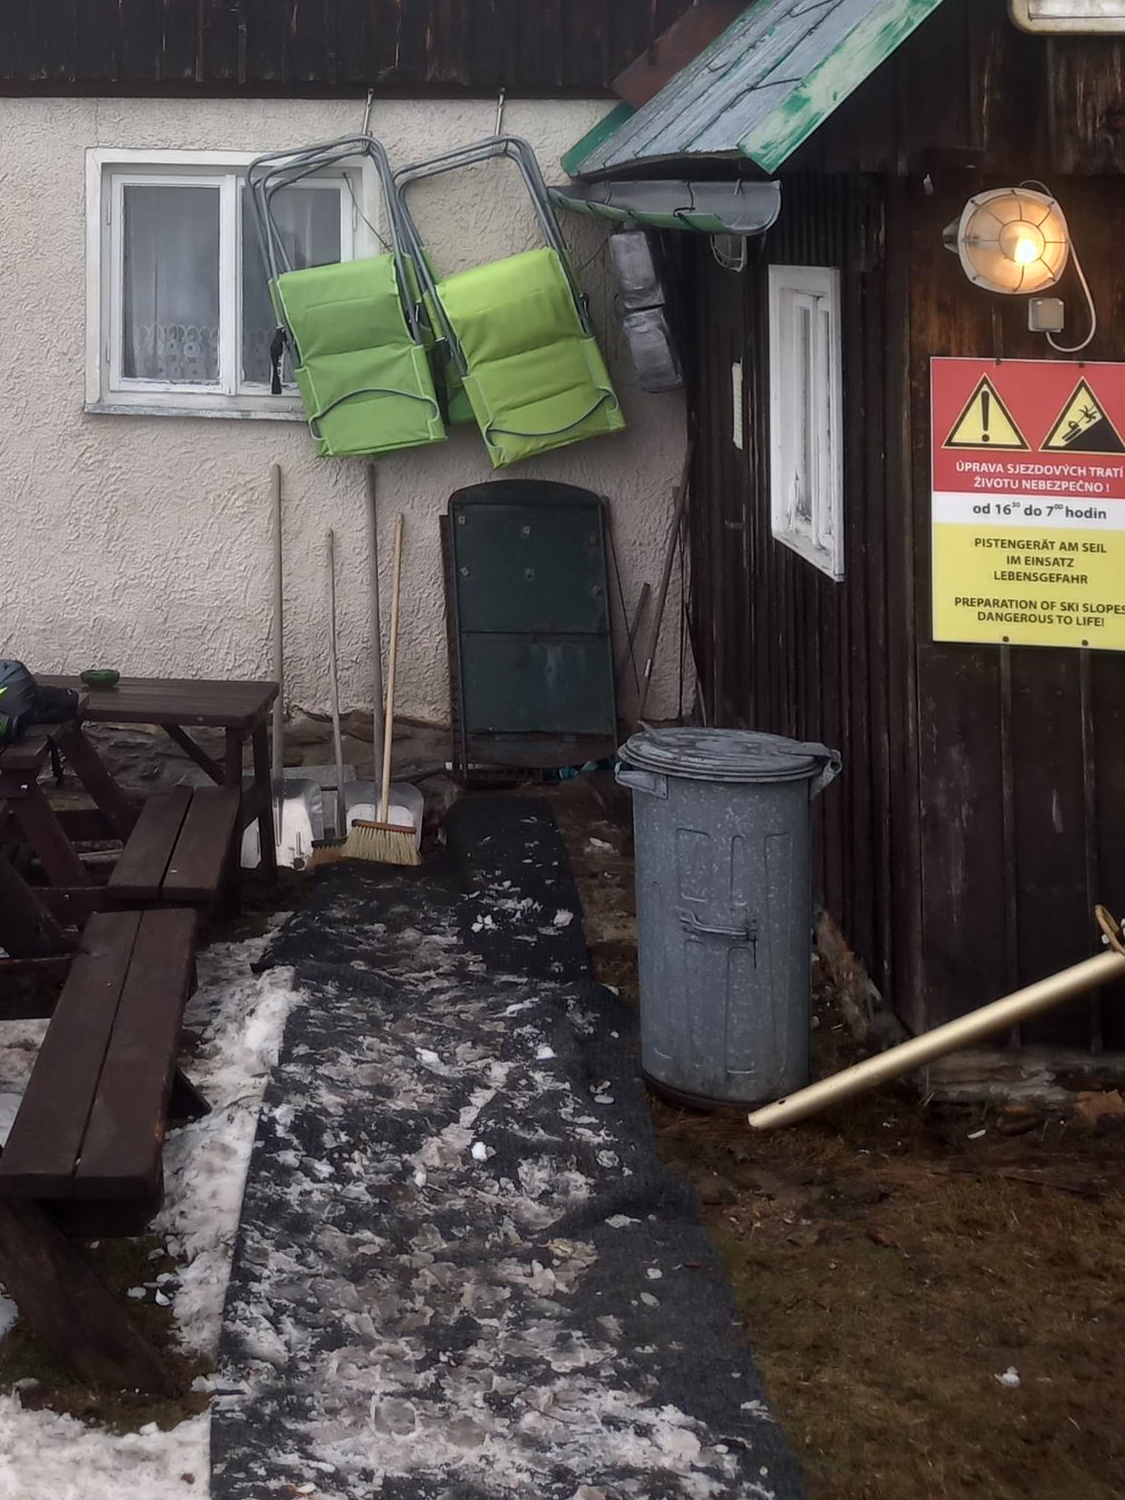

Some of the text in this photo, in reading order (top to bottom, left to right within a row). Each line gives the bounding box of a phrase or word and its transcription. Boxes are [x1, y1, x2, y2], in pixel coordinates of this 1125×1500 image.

[955, 461, 1124, 478] ÚPRAVA SJEZDOVÝCH TRATÍ
[973, 476, 1019, 489] ŽIVOTU
[1022, 479, 1104, 493] NEBEZPEČNO
[972, 503, 991, 515] od
[1024, 505, 1042, 517] do
[1065, 506, 1107, 520] hodin
[974, 538, 1107, 553] PISTENGERÄT AM SEIL
[1006, 555, 1075, 568] IM EINSATZ
[993, 570, 1088, 584] LEBENSGEFAHR
[954, 597, 1037, 610] PREPARATION
[1040, 600, 1056, 611] OF
[1060, 601, 1079, 612] SKI
[977, 611, 1105, 627] DANGEROUS TO LIFE!
